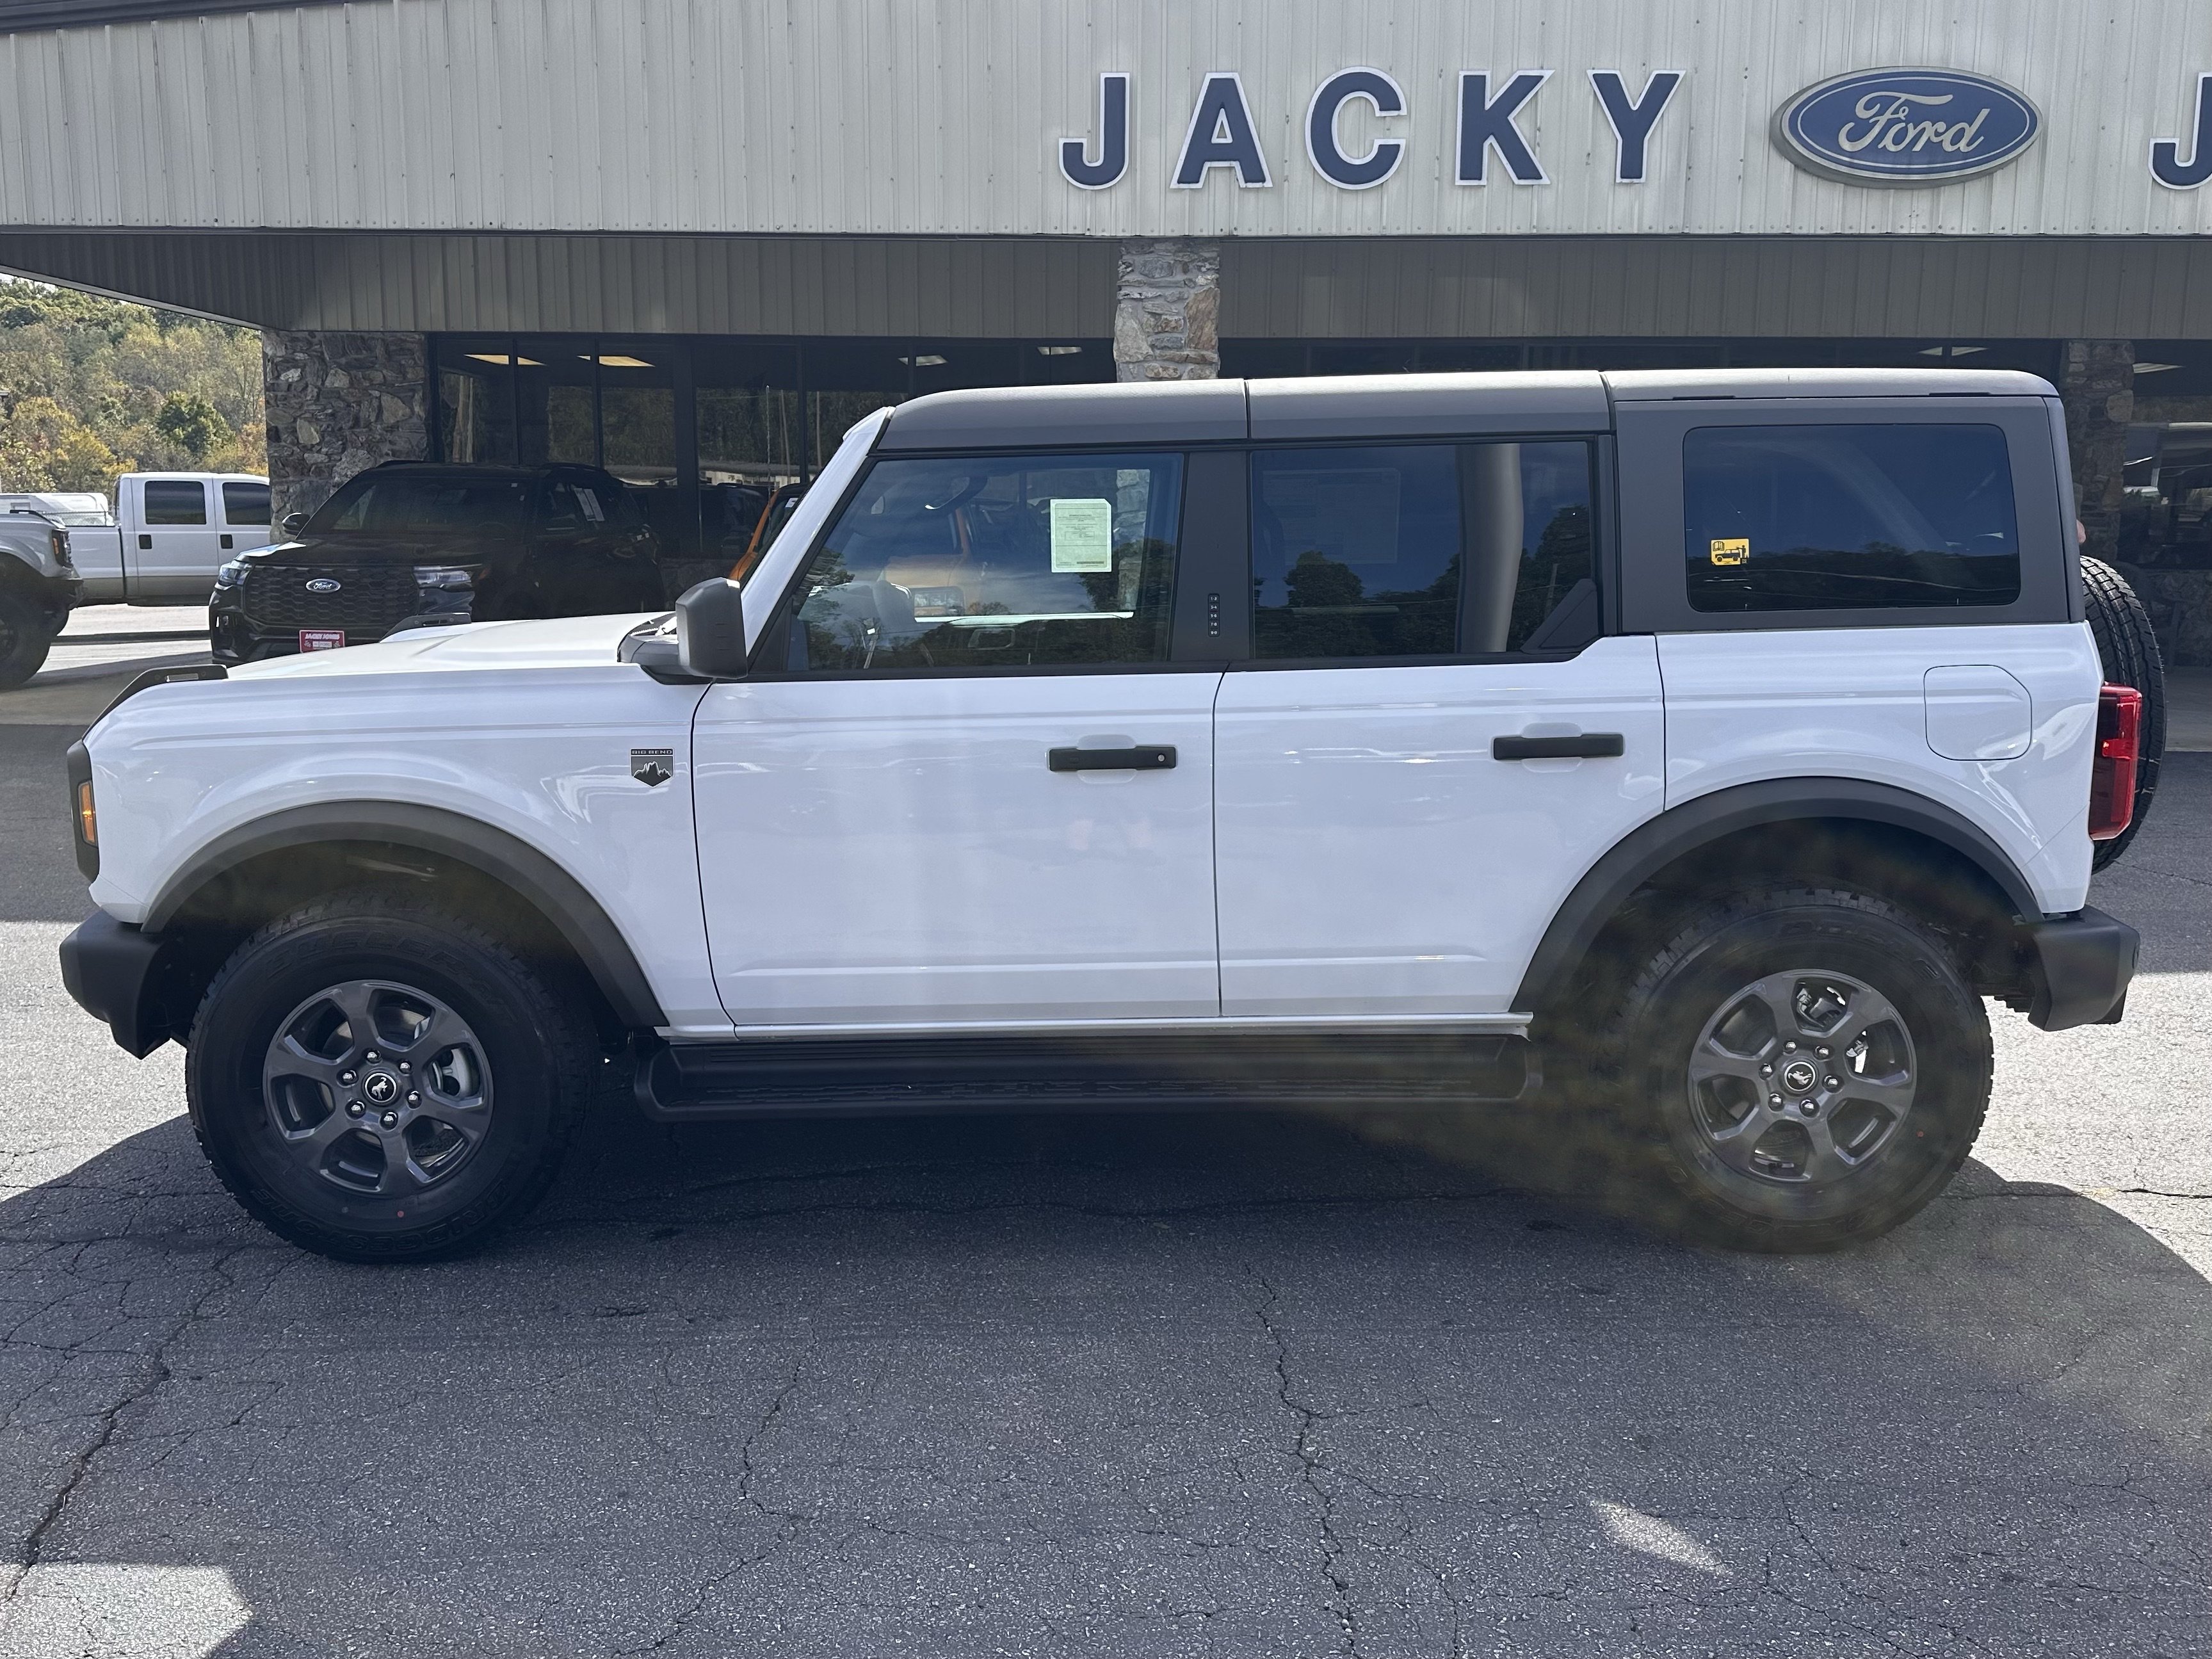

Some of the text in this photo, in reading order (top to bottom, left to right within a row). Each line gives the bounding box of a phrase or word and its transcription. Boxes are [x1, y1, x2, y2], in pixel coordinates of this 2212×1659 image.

[1058, 66, 1686, 191] JACKY
[1837, 91, 1990, 152] Ford
[313, 581, 332, 590] Ford
